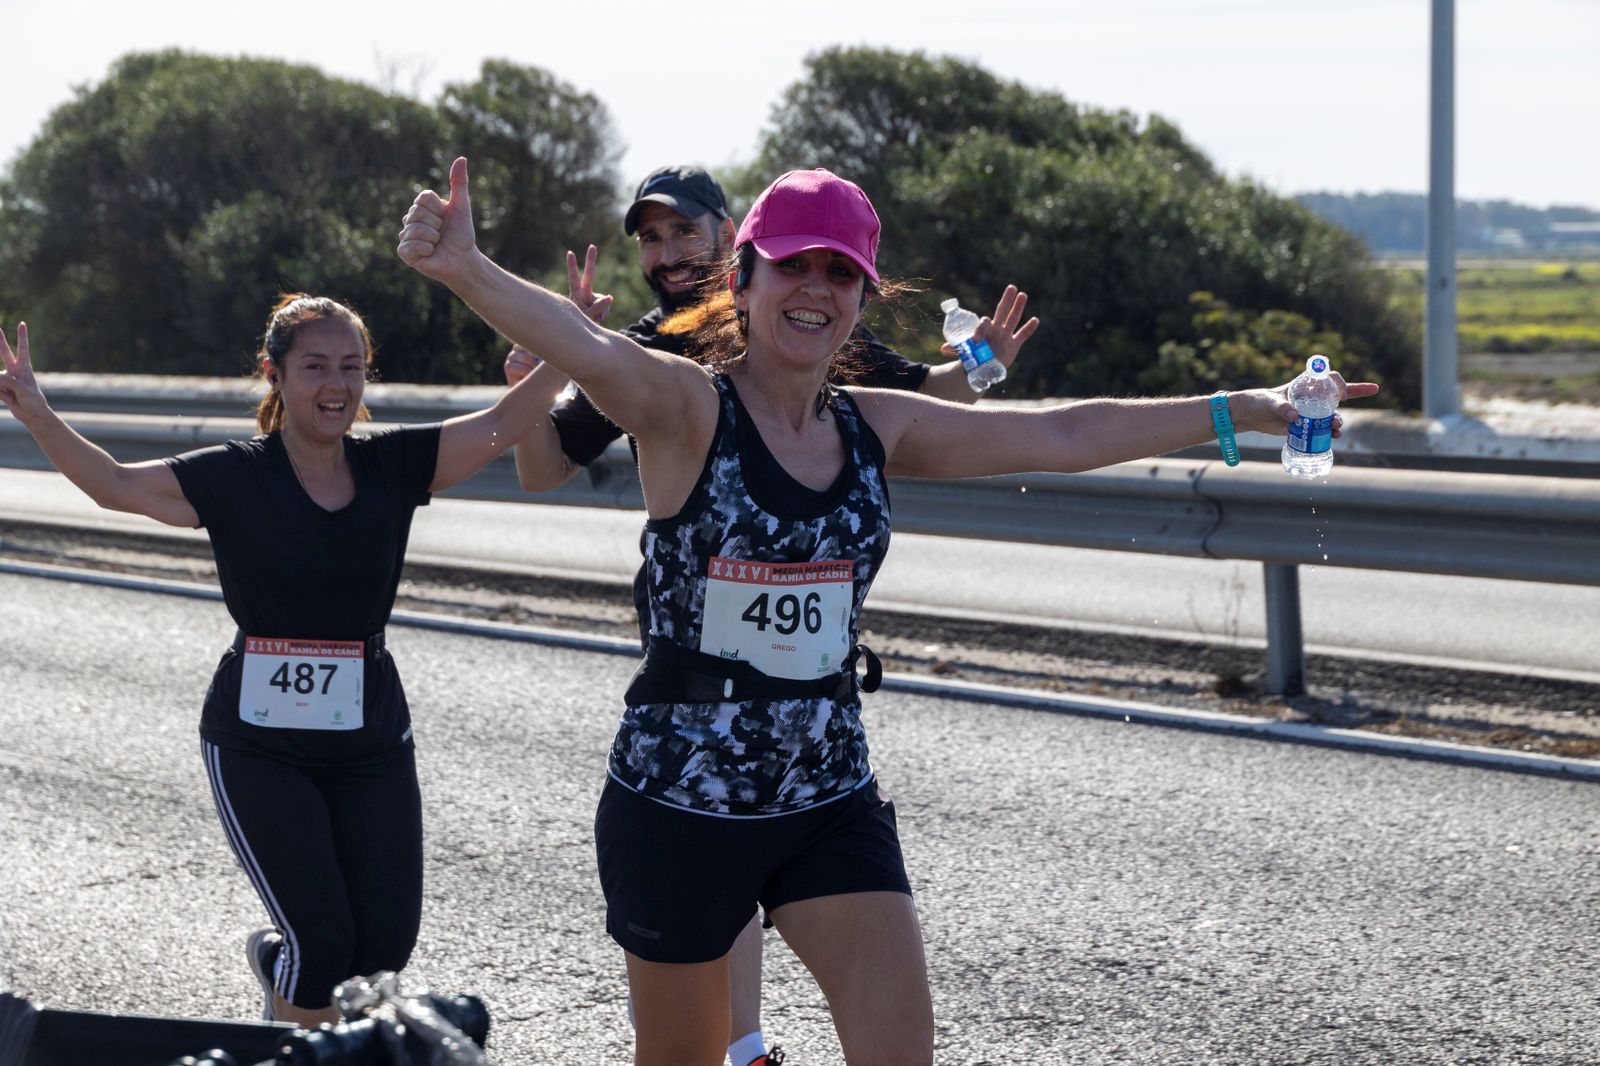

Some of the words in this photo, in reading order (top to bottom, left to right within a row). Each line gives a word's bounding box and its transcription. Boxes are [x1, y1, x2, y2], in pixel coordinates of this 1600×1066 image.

[712, 561, 769, 580] XXXVI
[772, 573, 804, 582] BAHÍA
[805, 573, 816, 581] DE
[819, 570, 849, 579] CÁDIZ
[773, 566, 803, 575] MEDIA
[741, 592, 822, 635] 496
[719, 648, 740, 660] imd
[269, 662, 339, 695] 487
